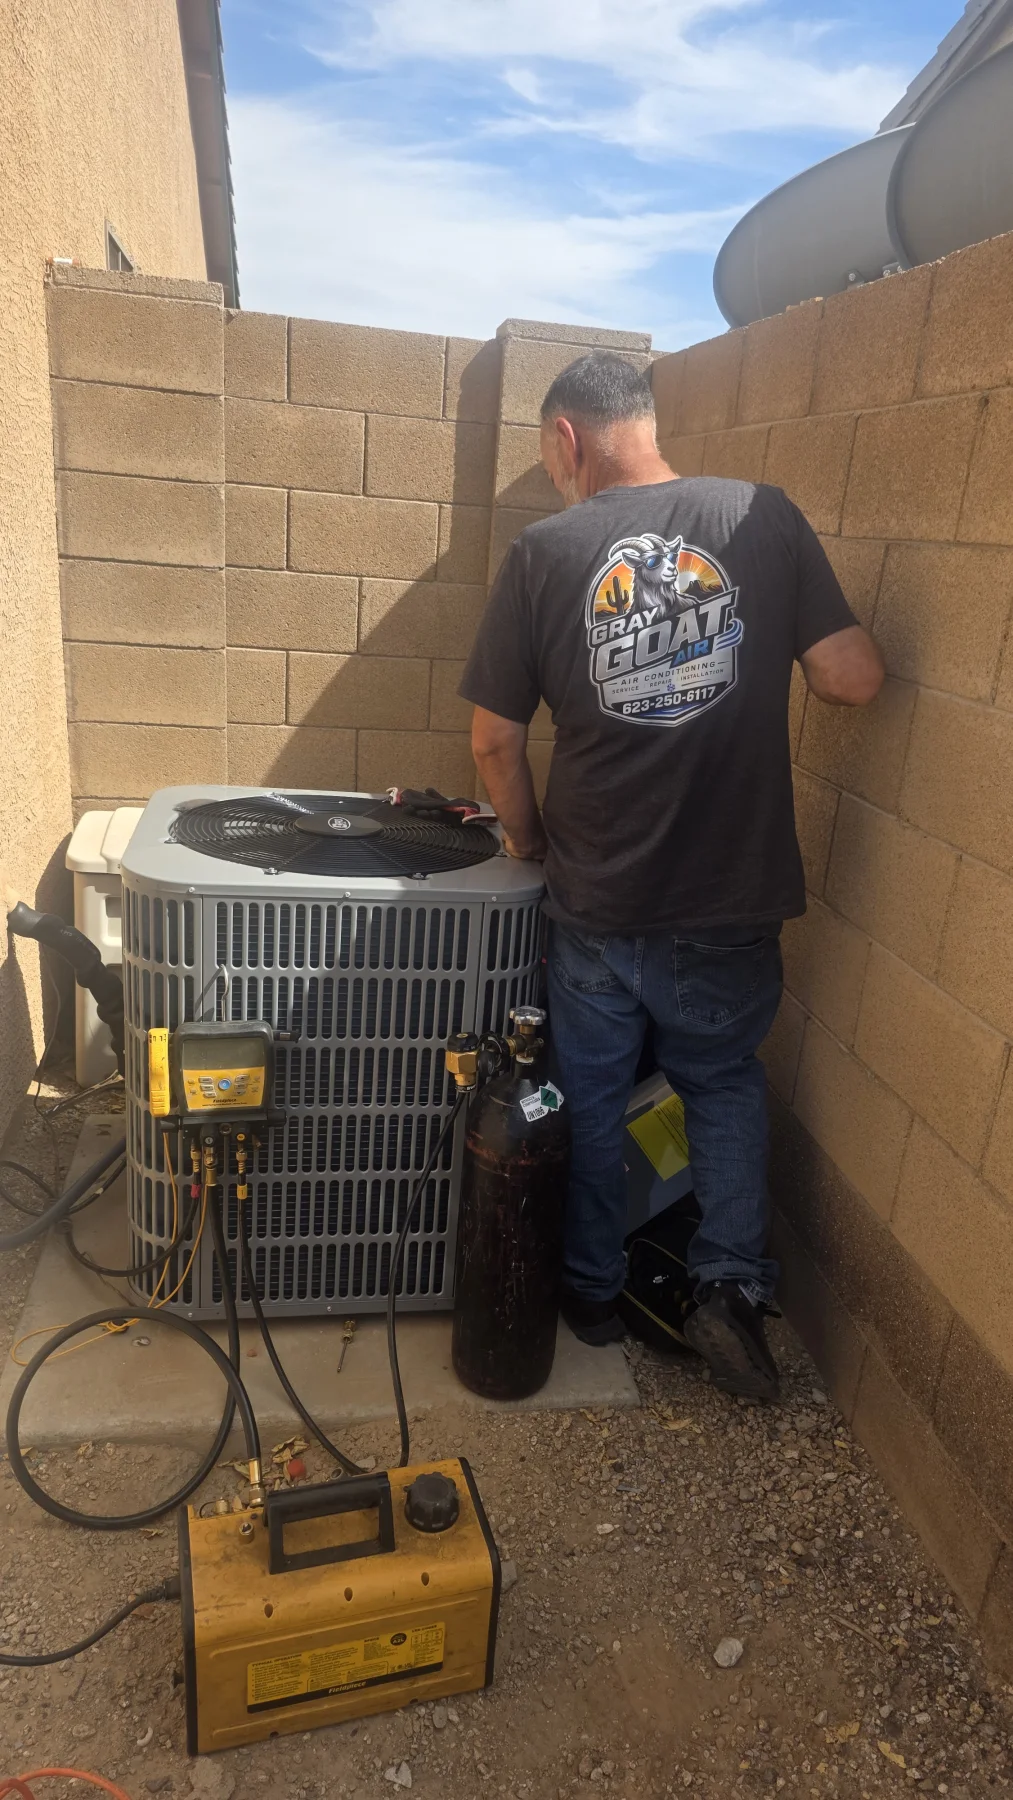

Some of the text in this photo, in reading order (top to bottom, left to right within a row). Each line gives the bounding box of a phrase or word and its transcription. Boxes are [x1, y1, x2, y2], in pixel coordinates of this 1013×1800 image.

[592, 607, 658, 645] GRAY
[596, 593, 732, 681] GOAT
[673, 639, 709, 666] AIR
[612, 669, 724, 694] SERVICE REPAIR INSTALLATION
[621, 661, 716, 686] AIR CONDITIONING
[622, 686, 716, 715] 623-250-6117
[328, 1681, 367, 1694] Fieldpiece
